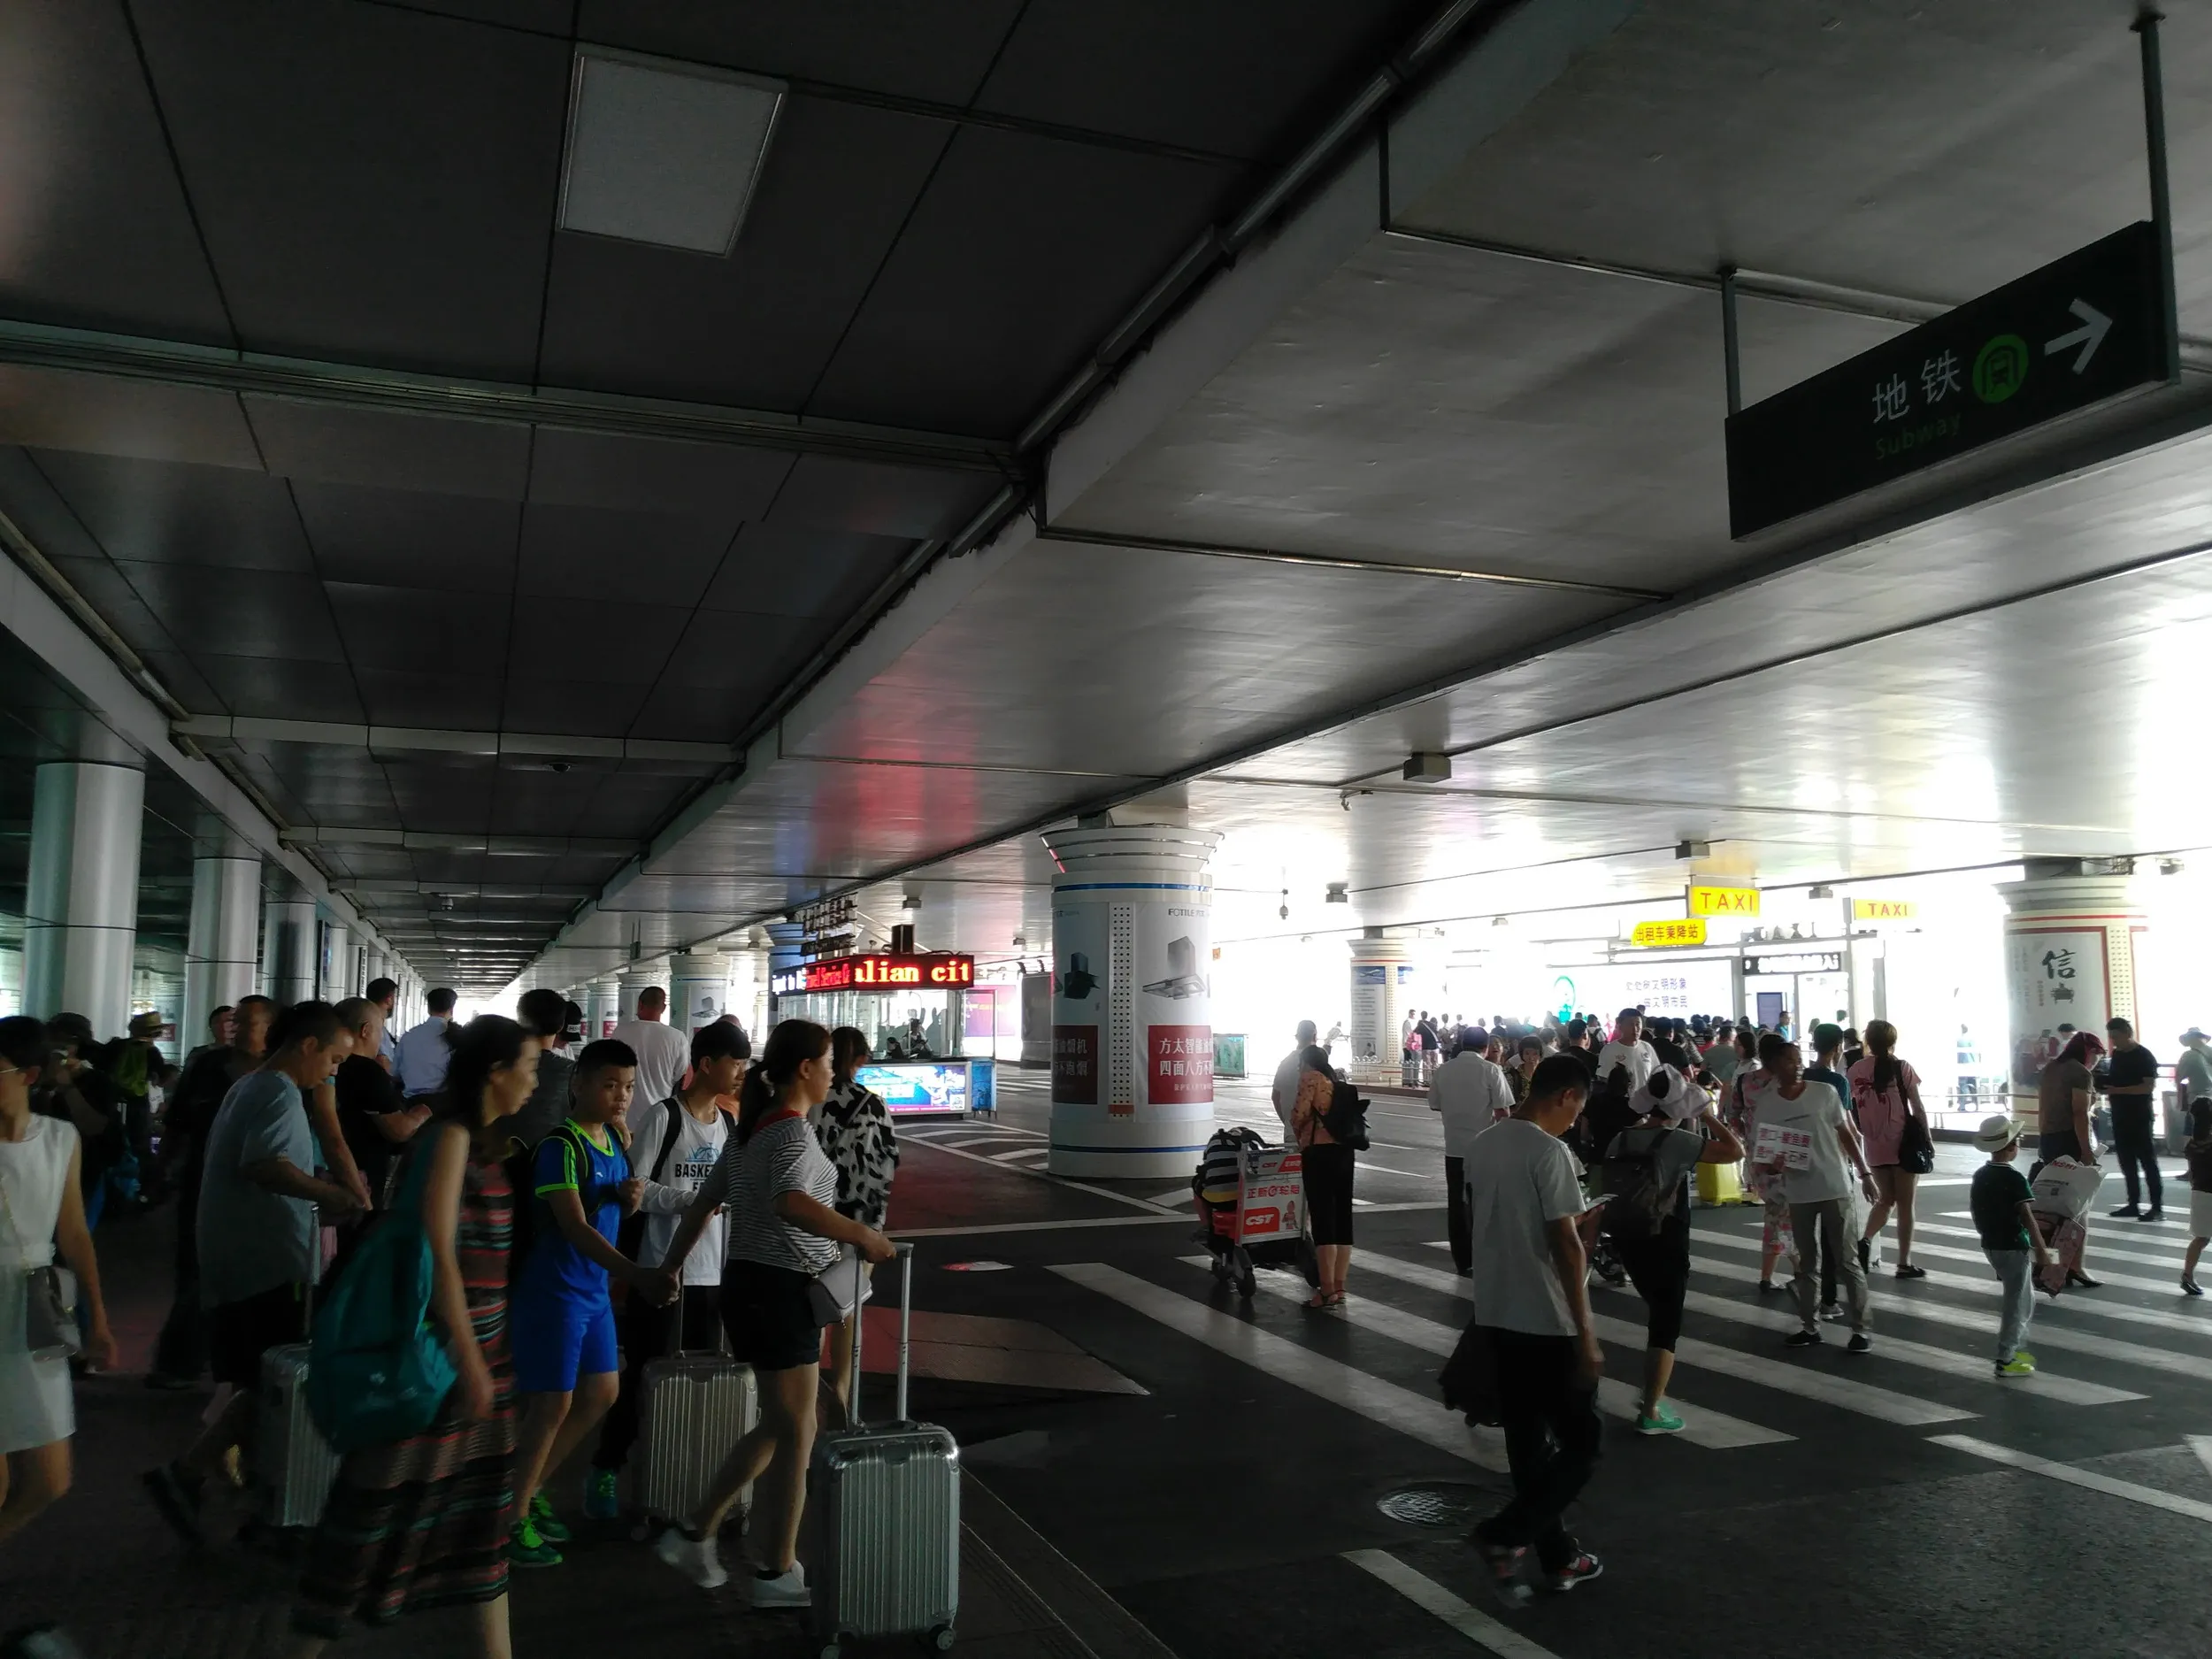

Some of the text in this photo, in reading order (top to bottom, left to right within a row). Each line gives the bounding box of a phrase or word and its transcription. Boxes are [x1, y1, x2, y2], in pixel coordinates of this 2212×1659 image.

[1871, 349, 1962, 424] 地铁
[1700, 892, 1753, 912] TAXI
[1868, 902, 1908, 917] TAXI
[1168, 908, 1194, 917] FOTILE
[1636, 923, 1699, 941] 出租车乘降站
[2042, 949, 2076, 979] 信
[1245, 1214, 1275, 1225] CST
